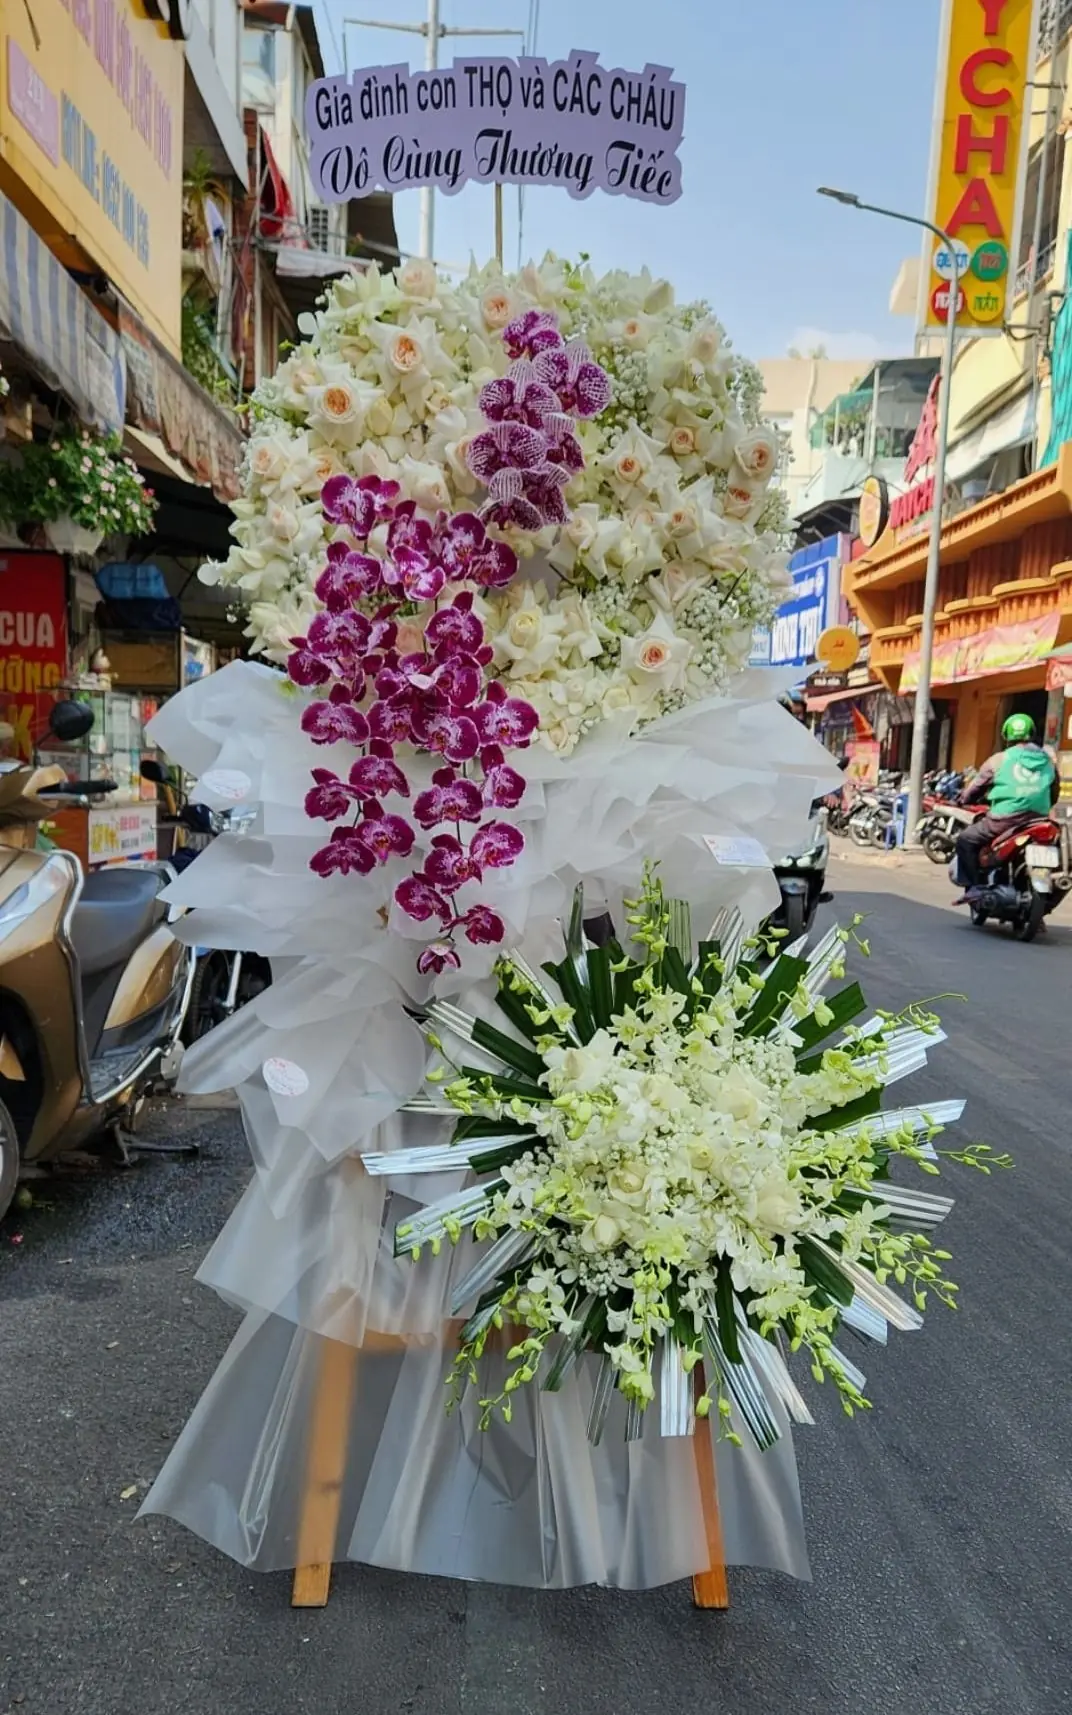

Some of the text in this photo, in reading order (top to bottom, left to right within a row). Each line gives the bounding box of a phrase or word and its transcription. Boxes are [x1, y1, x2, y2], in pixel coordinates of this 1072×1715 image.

[315, 60, 674, 131] Gia đình con THỌ và CÁC CHÁU
[320, 128, 674, 198] Vô Cùng Thương Tiếc
[0, 612, 56, 648] CUA
